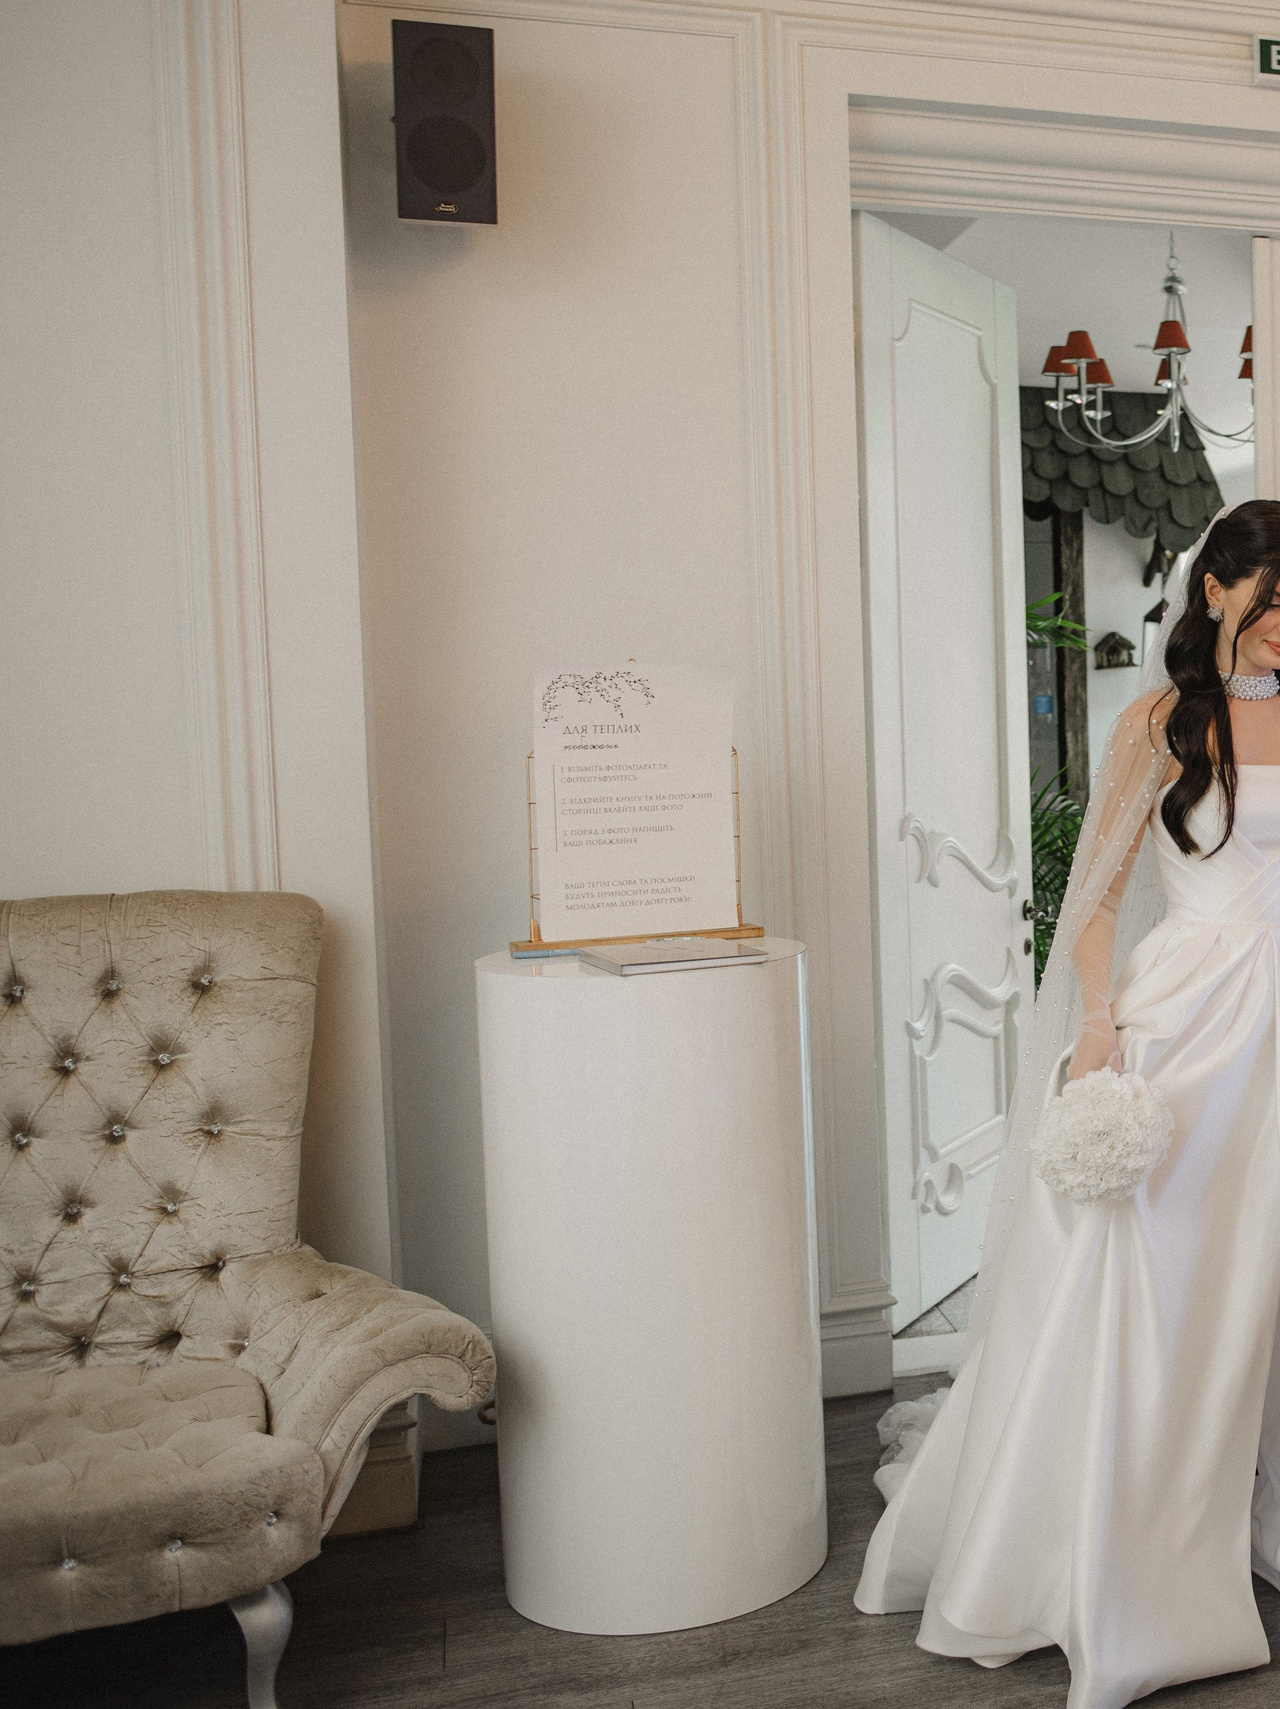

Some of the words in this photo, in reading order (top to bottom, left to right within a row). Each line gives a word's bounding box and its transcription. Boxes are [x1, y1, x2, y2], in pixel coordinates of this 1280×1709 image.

[562, 725, 588, 735] ДЛЯ
[592, 724, 642, 734] ТЕПЛИХ
[567, 765, 604, 773] ВІЗЬМІТЬ
[605, 763, 657, 772] ФОТОАПАРАТ
[560, 774, 639, 784] СФОТОГРАФУЙТЕСЬ
[569, 796, 614, 805] ВІДКРИЙТЕ
[616, 795, 642, 803] КНИГУ
[668, 791, 713, 801] ПОРОЖНІЙ
[561, 807, 602, 816] СТОРІНЦІ
[603, 805, 637, 814] ВКЛЕЙТЕ
[638, 804, 659, 812] ВАШЕ
[660, 803, 684, 811] ФОТО
[570, 828, 600, 836] ПОРЯД
[606, 826, 631, 835] ФОТО
[632, 824, 675, 833] НАПИШІТЬ
[585, 837, 638, 846] ПОБАЖАННЯ
[587, 880, 610, 888] ТЕПЛІ
[611, 879, 638, 887] СЛОВА
[650, 875, 695, 884] ПОСМІШКИ
[565, 892, 595, 901] БУДУТЬ
[597, 888, 649, 898] ПРИНОСИТИ
[651, 886, 682, 894] РАДІСТЬ
[565, 901, 617, 910] МОЛОДЯТАМ
